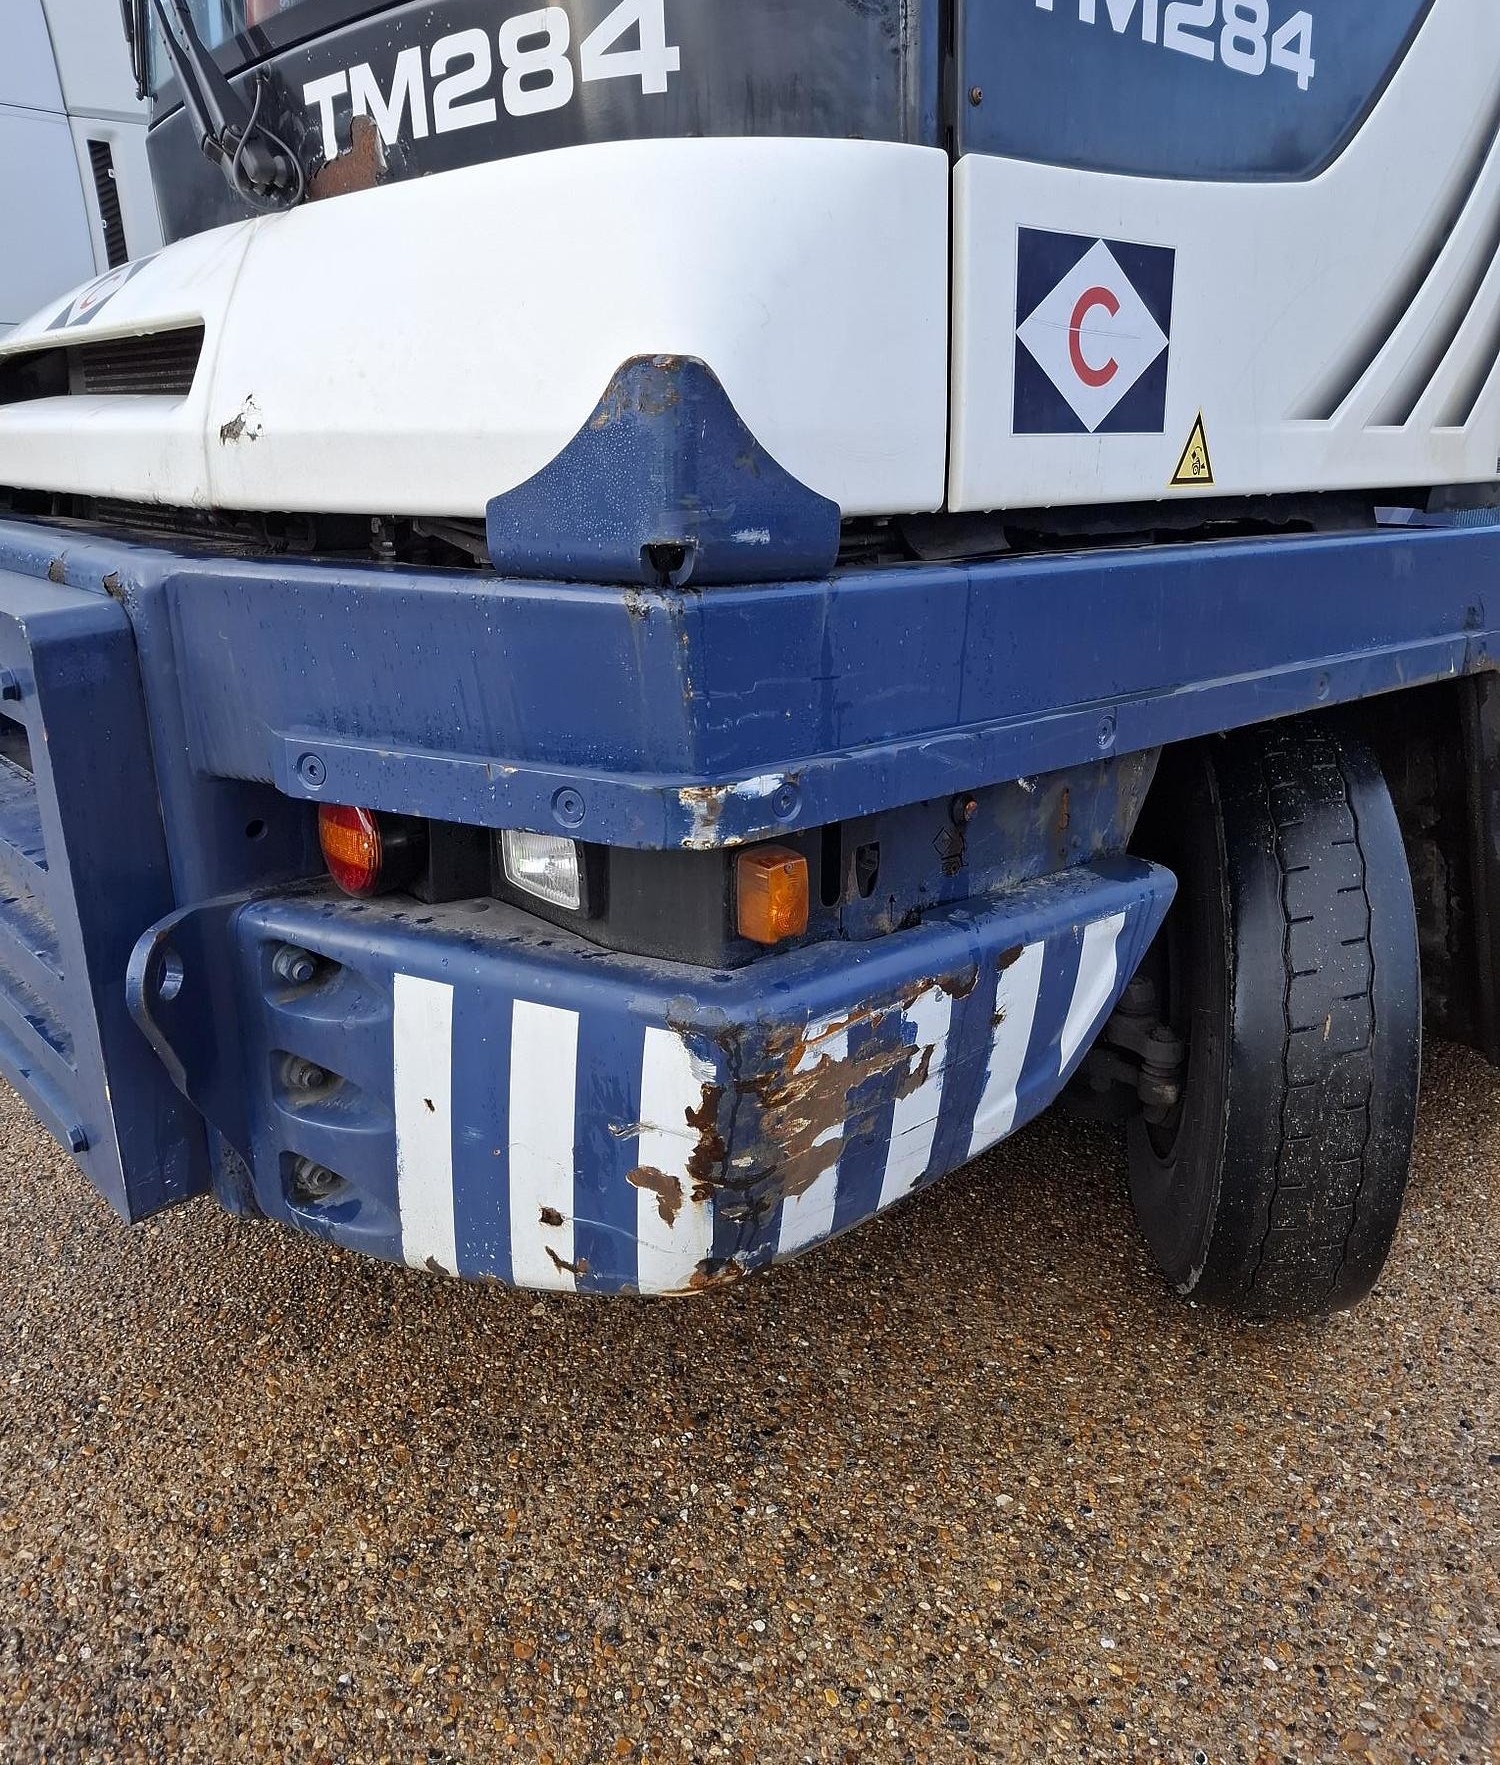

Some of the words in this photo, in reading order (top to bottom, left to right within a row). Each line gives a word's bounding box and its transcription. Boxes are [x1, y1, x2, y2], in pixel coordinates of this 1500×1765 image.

[303, 0, 680, 168] TM284
[1035, 0, 1315, 91] 284
[80, 272, 121, 309] C
[1068, 285, 1120, 387] C
